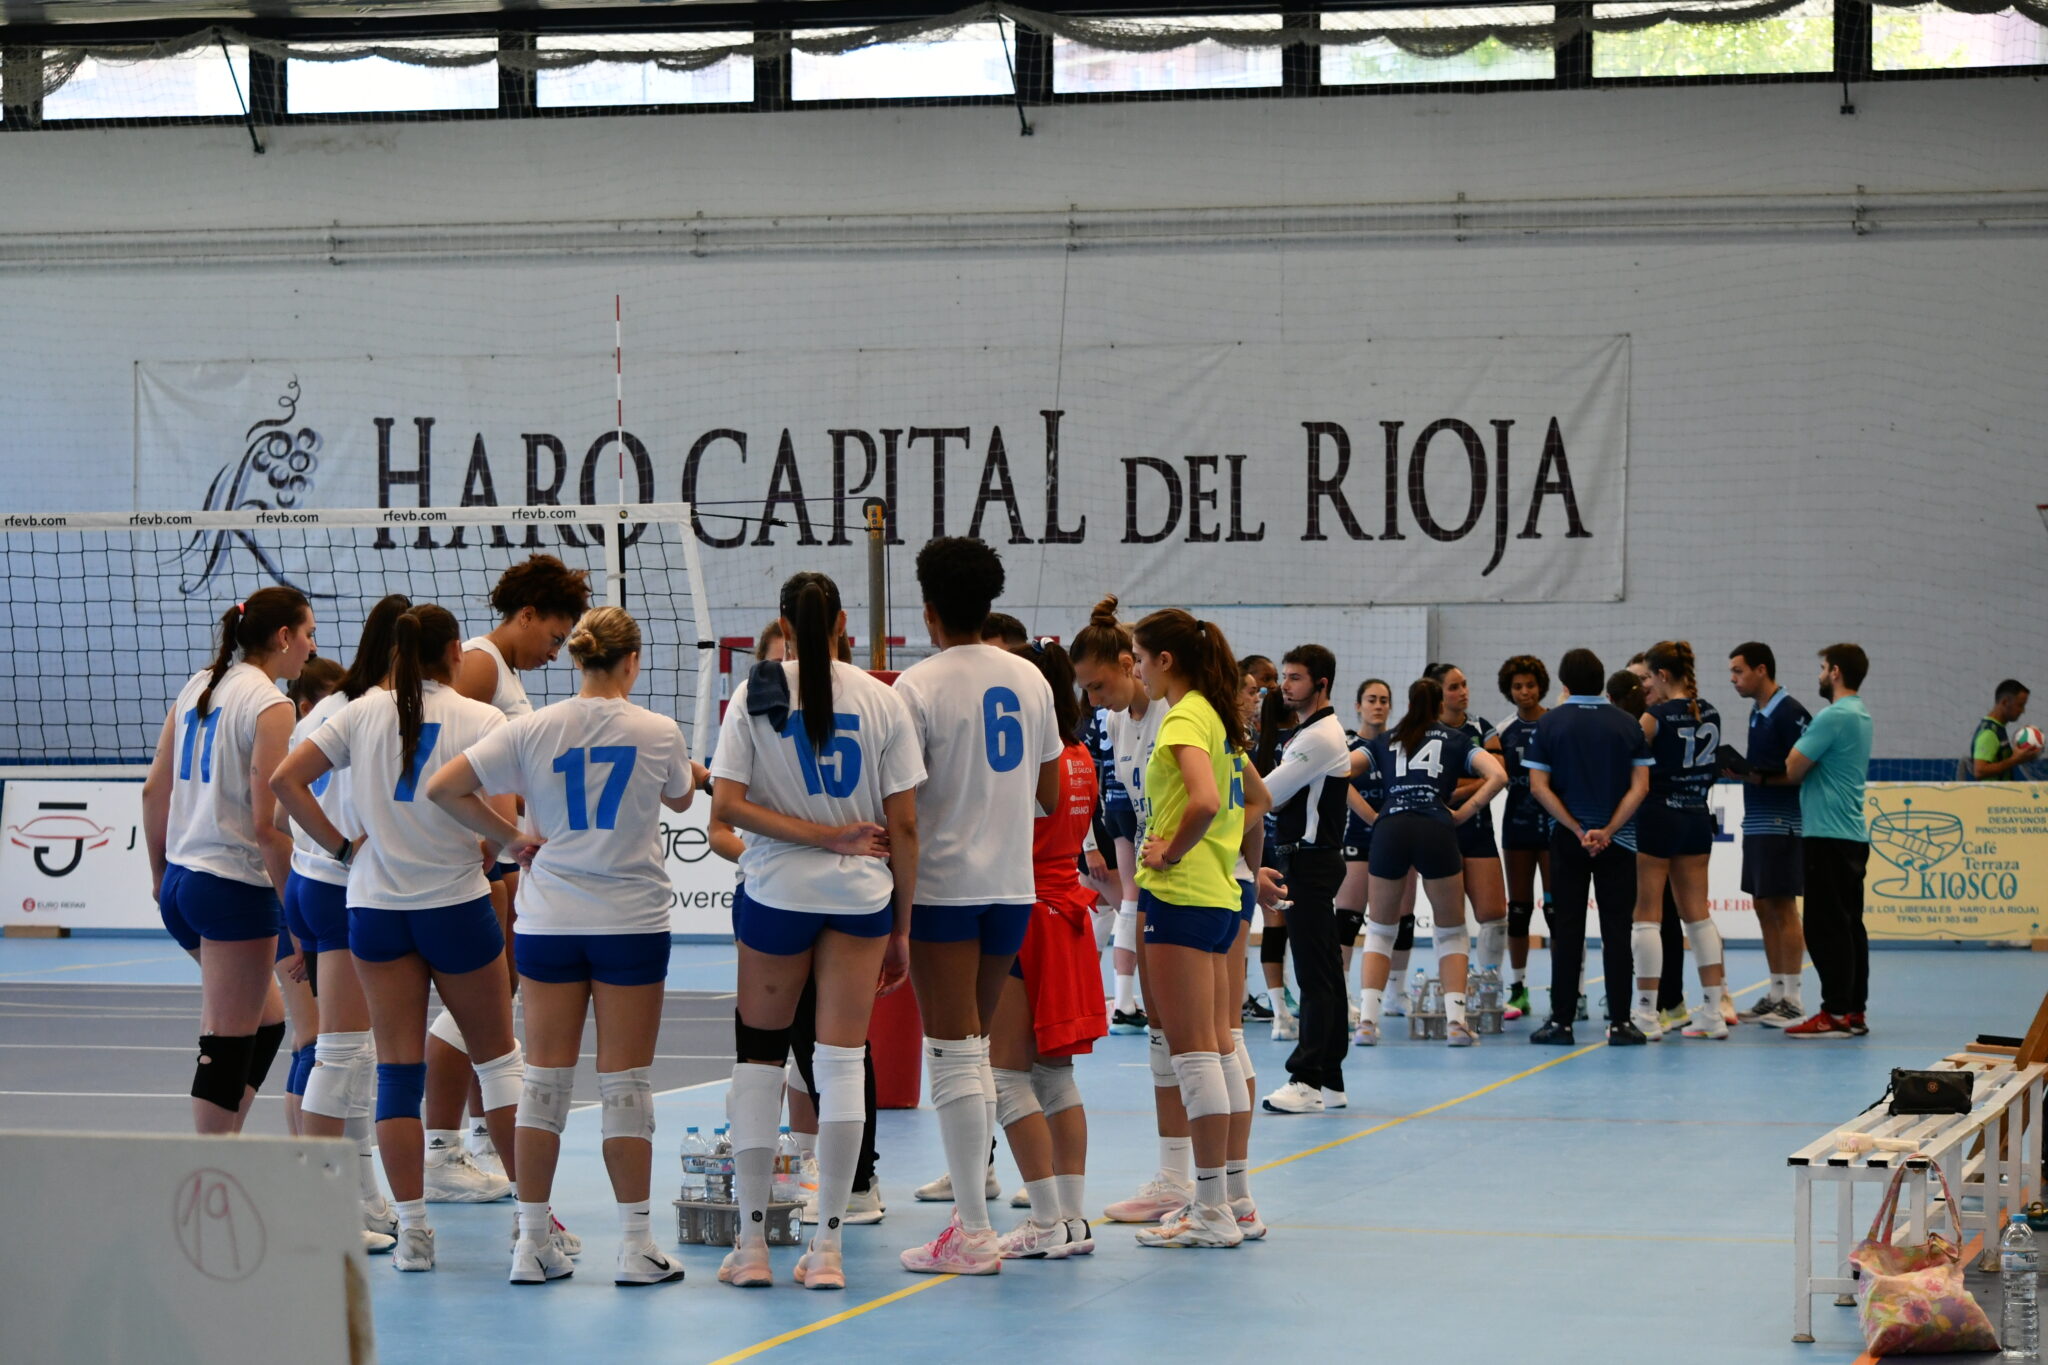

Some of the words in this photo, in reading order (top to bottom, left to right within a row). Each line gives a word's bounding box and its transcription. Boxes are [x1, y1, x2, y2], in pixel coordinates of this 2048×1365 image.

[373, 416, 655, 550] HARO
[682, 410, 1087, 550] CAPITAL
[1120, 454, 1265, 545] DEL
[1300, 416, 1594, 577] RIOJA
[4, 514, 67, 528] rfevb.com
[129, 513, 193, 527] rfevb.com
[256, 512, 319, 525] rfevb.com
[383, 510, 447, 523] rfevb.com
[512, 508, 577, 521] rfevb.com
[179, 706, 223, 783] 11
[983, 686, 1024, 773] 6
[1677, 721, 1720, 769] 12
[394, 722, 442, 802] 7
[779, 709, 863, 799] 15
[1388, 739, 1444, 779] 14
[552, 745, 638, 831] 17
[1961, 840, 1998, 855] Café
[1961, 856, 2020, 871] Terraza
[1920, 871, 2018, 900] KIOSCO
[182, 1173, 242, 1273] 19
